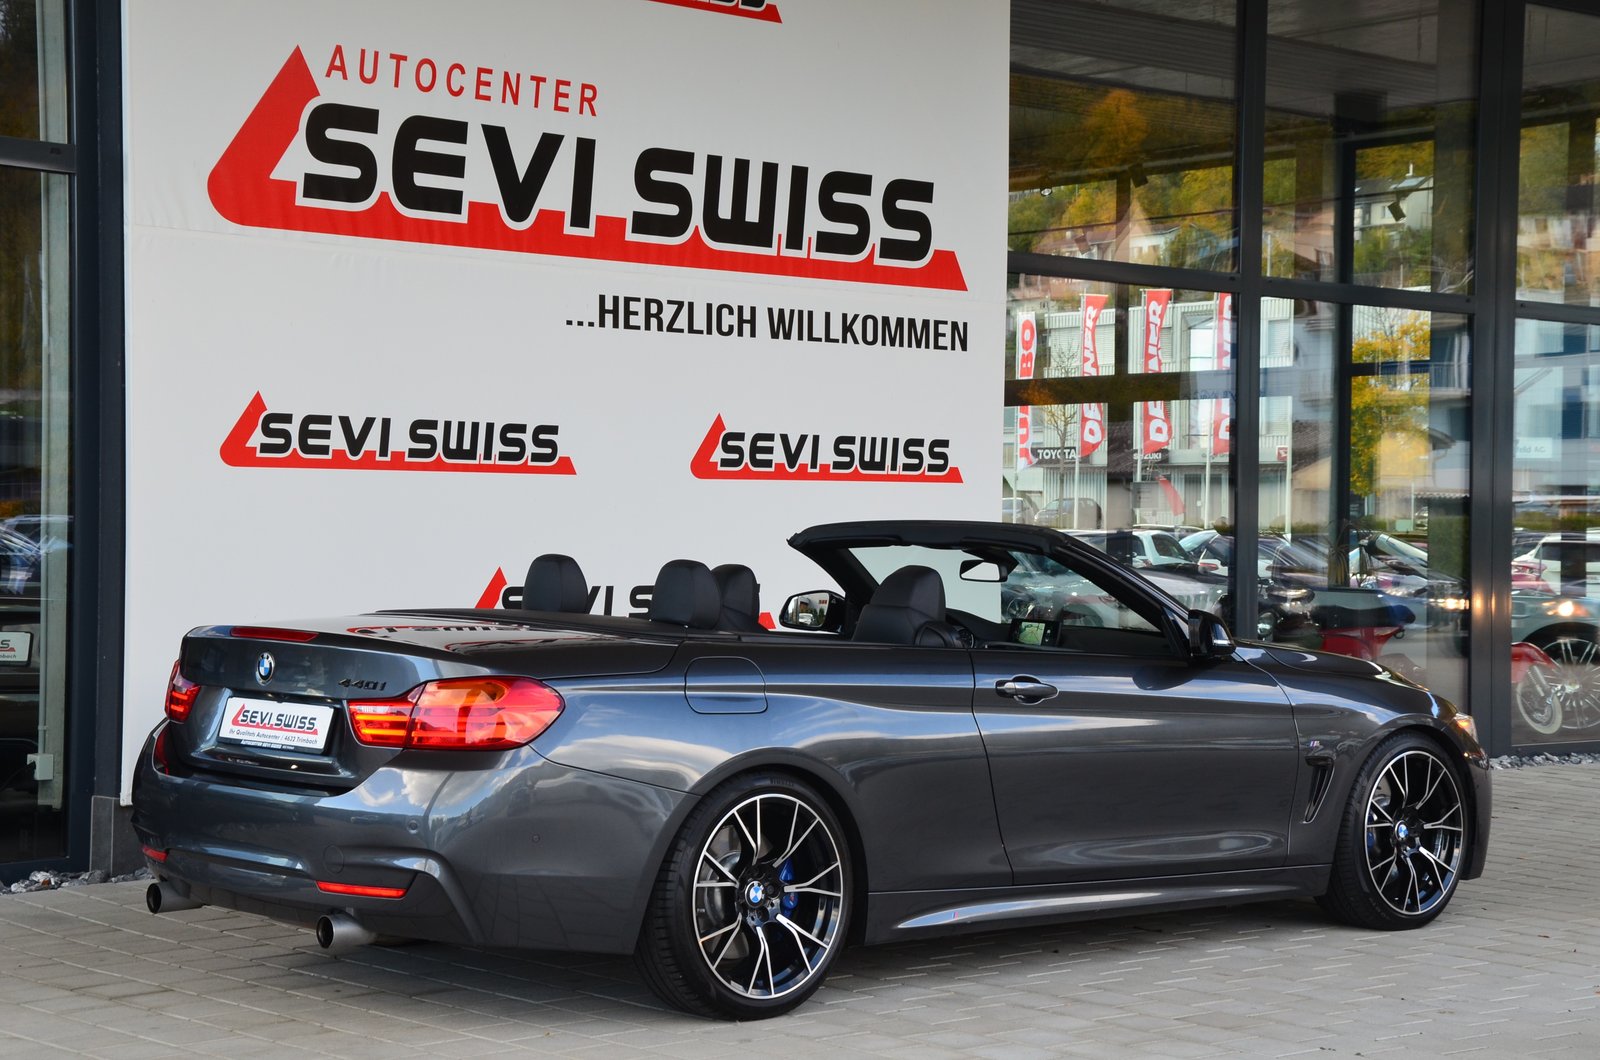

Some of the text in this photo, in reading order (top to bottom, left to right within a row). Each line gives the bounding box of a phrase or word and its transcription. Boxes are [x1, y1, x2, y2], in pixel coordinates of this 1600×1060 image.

[326, 45, 597, 116] AUTOCENTER
[303, 103, 934, 261] SEVI SWISS
[567, 295, 968, 351] ...HERZLICH WILLKOMMEN
[260, 413, 558, 463] SEVI SWISS
[720, 432, 949, 472] SEVI SWISS
[240, 709, 317, 731] SEVI SWISS
